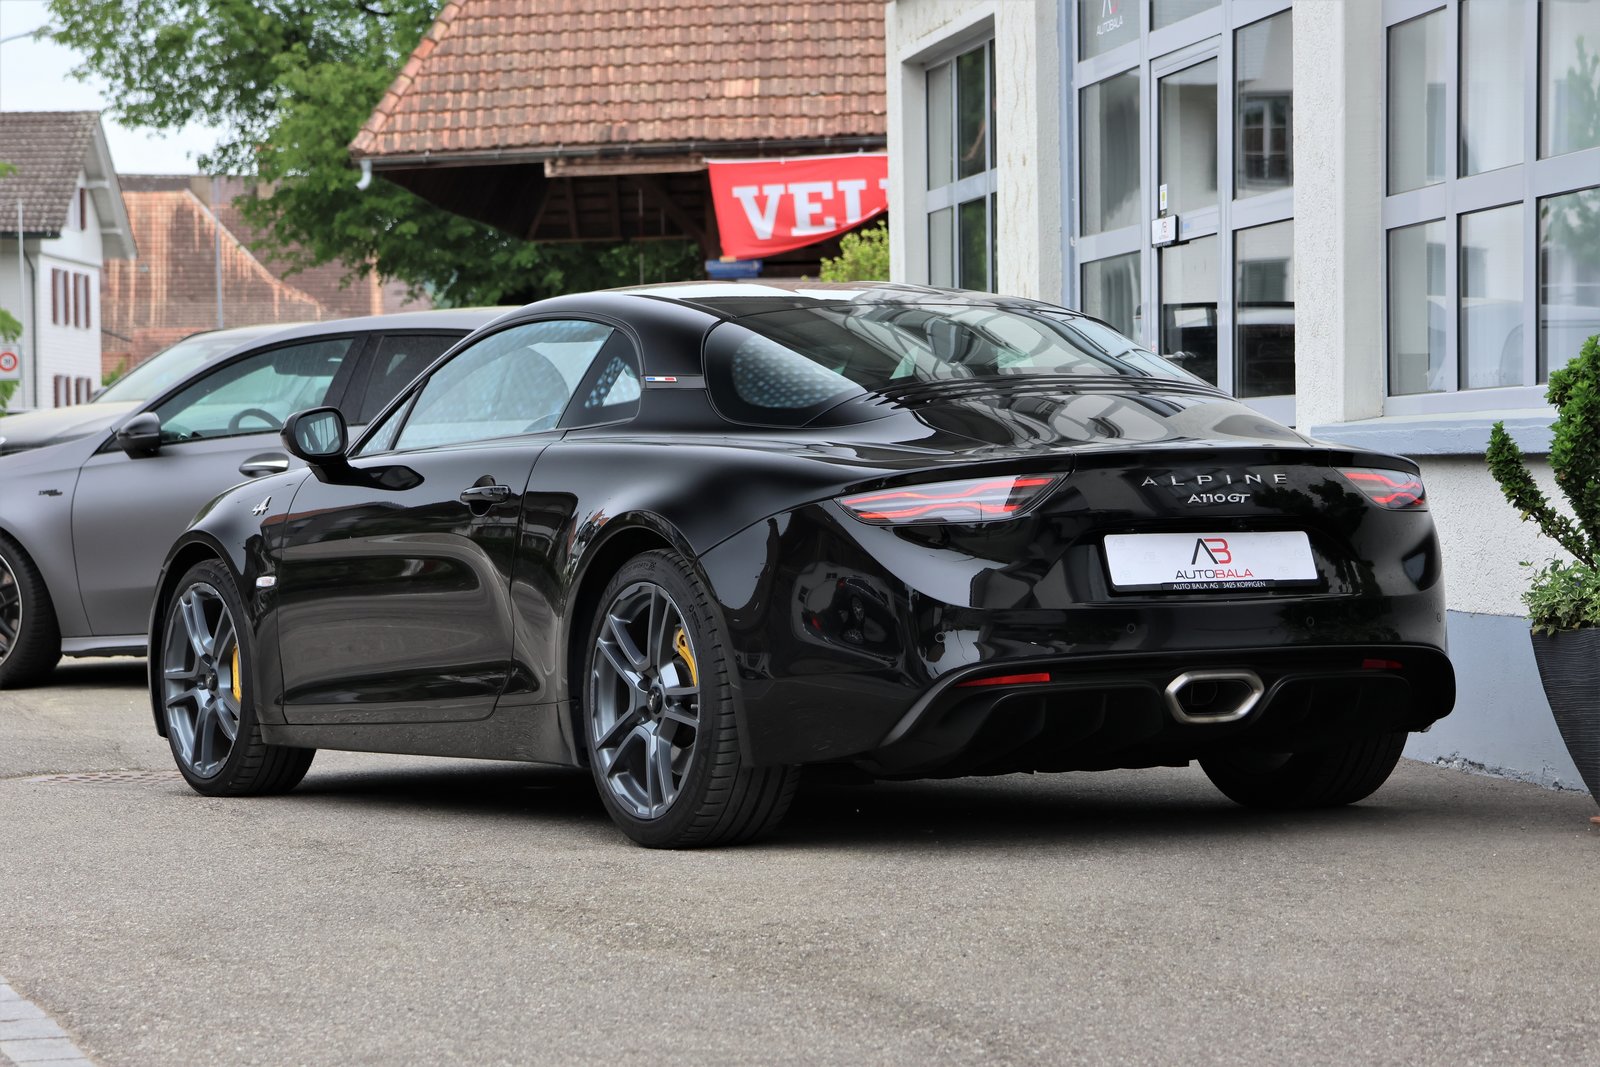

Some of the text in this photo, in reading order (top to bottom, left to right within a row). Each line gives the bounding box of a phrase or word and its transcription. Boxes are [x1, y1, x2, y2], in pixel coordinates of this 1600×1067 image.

[731, 178, 889, 241] VEL
[1141, 473, 1288, 487] ALPINE
[1175, 568, 1254, 580] AUTOBALA
